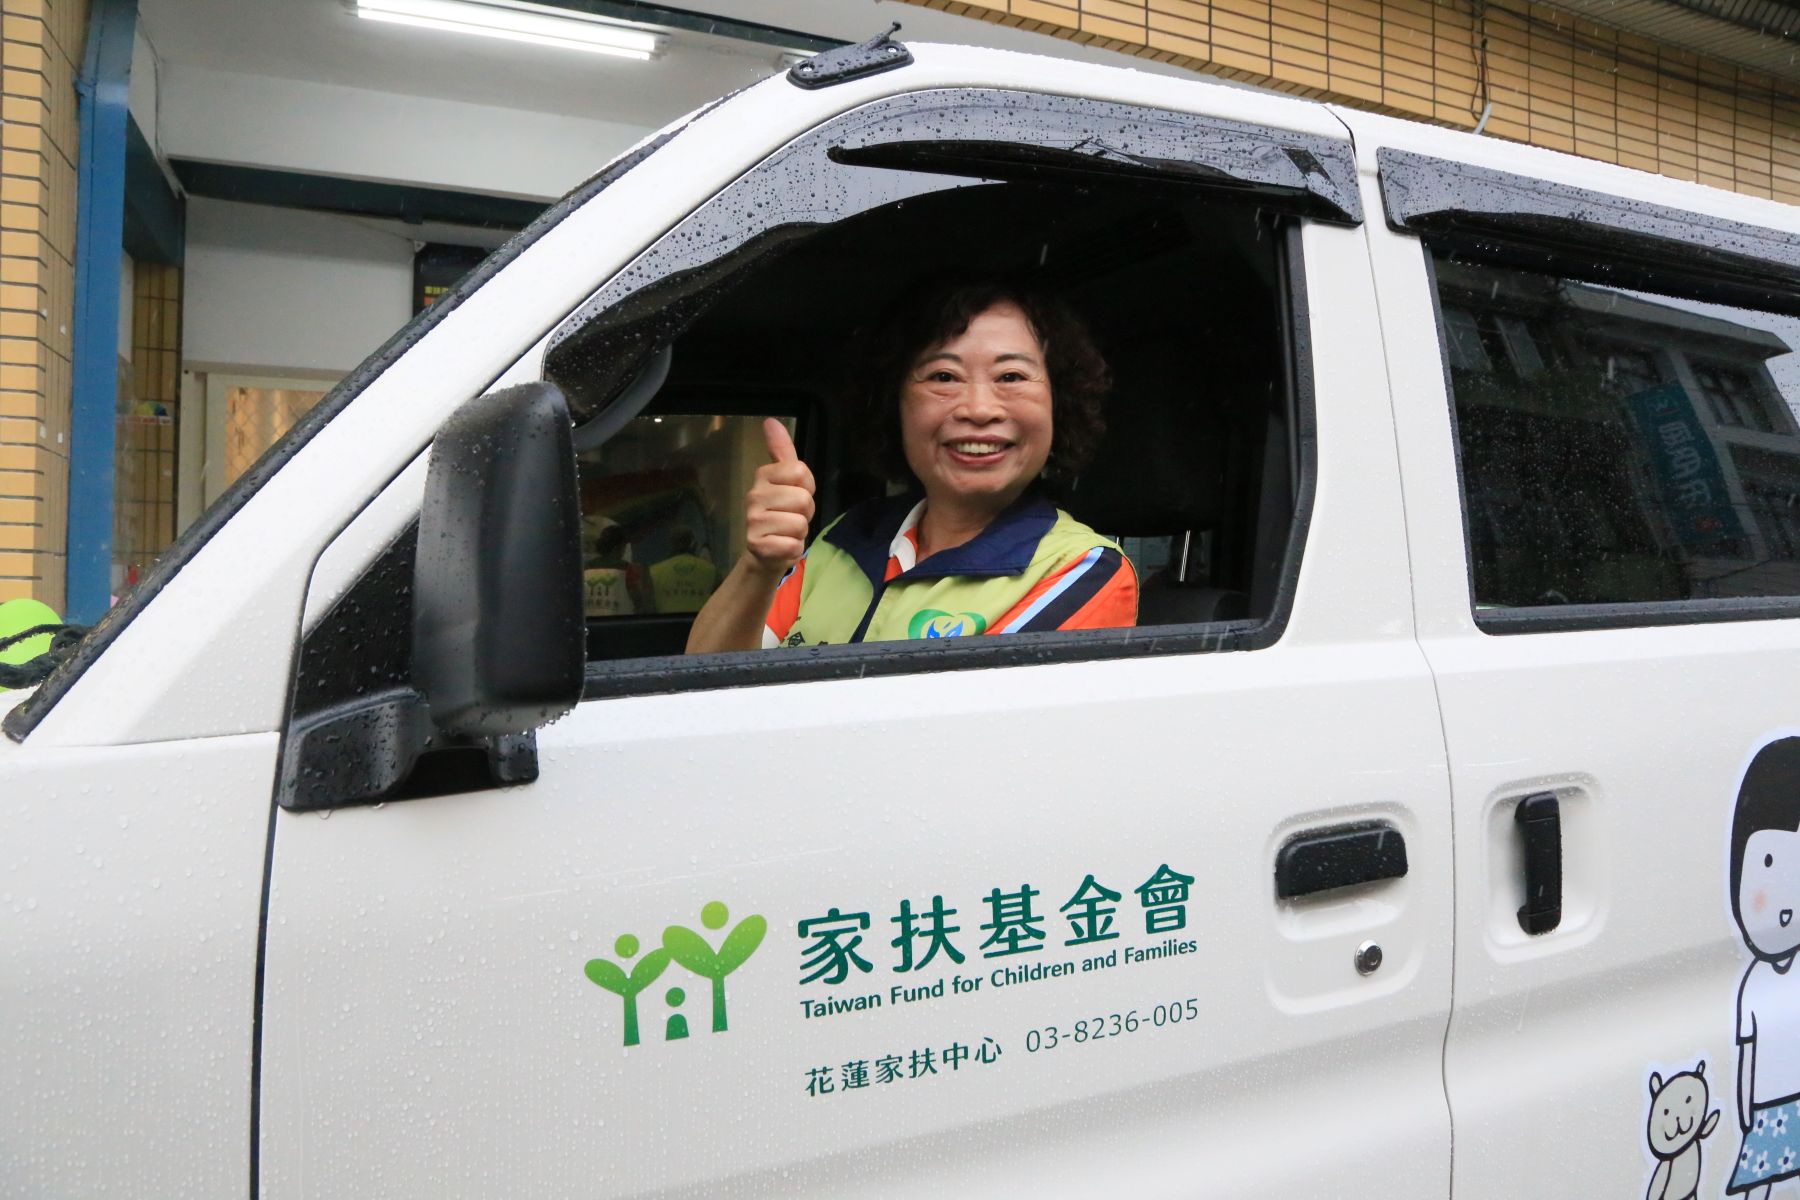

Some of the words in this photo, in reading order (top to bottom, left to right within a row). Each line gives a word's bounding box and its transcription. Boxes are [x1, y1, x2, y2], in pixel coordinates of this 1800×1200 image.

[797, 863, 1196, 986] 家扶基金會
[801, 993, 882, 1019] Taiwan
[890, 976, 944, 1006] Fund
[952, 972, 983, 993] for
[990, 958, 1075, 988] Children
[1081, 949, 1117, 974] and
[1124, 940, 1197, 966] Families
[1025, 998, 1199, 1053] 03-8236-005
[805, 1036, 1002, 1097] 花蓮家扶中心
